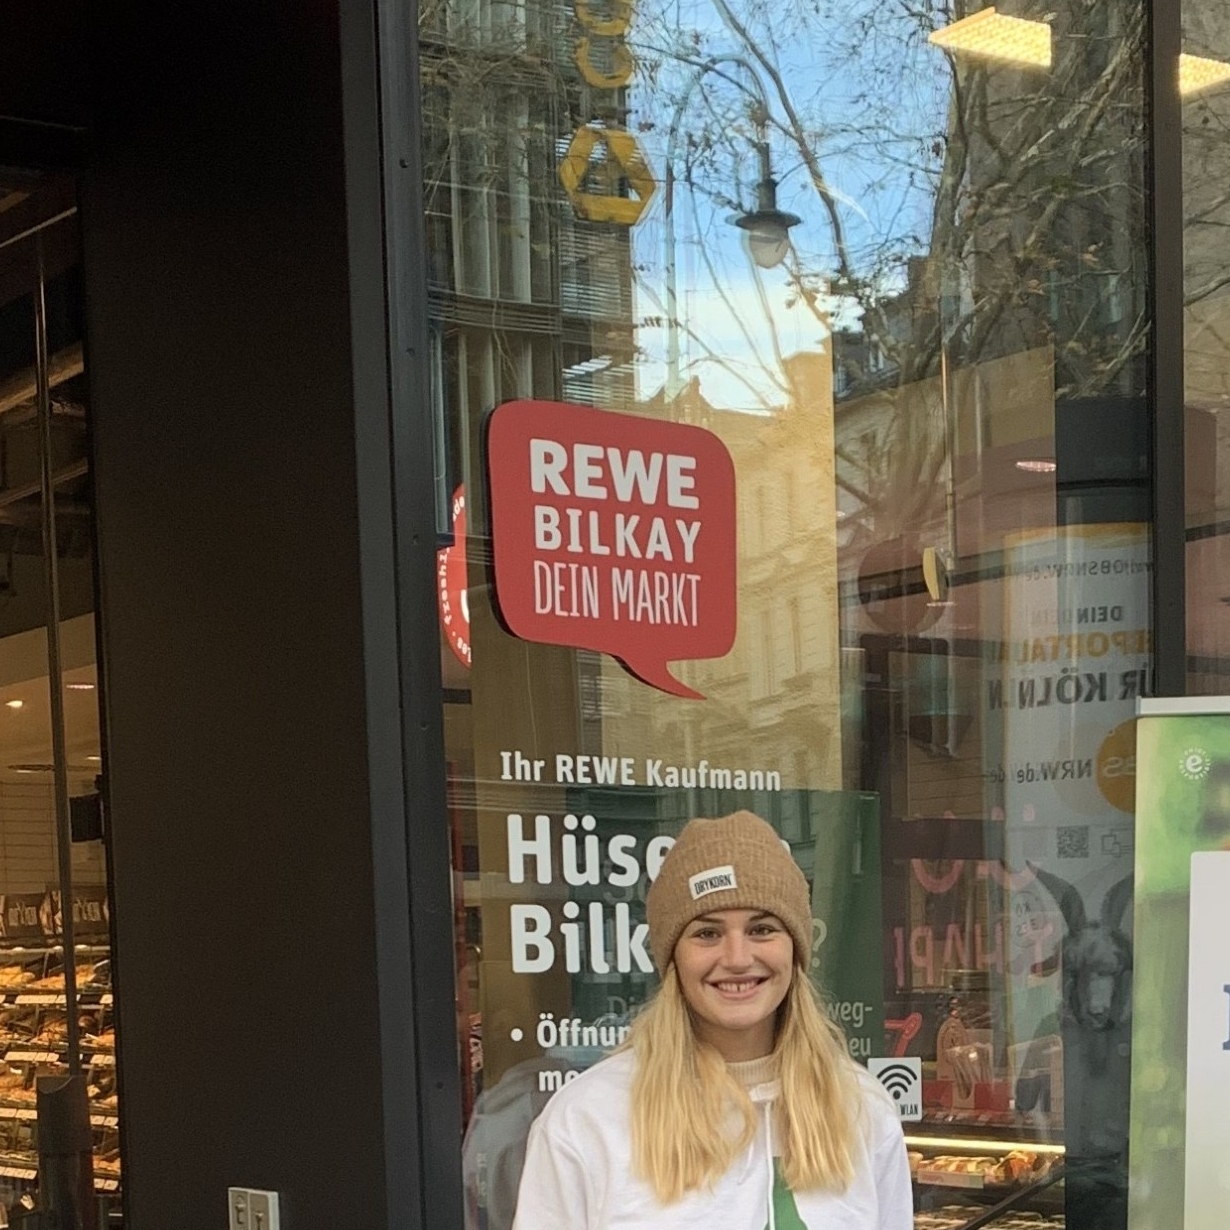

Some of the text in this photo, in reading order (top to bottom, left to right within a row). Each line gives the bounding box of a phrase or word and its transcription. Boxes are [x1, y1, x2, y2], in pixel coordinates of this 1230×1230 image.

[530, 438, 701, 511] REWE
[534, 505, 701, 563] BILKAY
[533, 560, 701, 626] DEIN MARKT
[500, 751, 782, 792] Ihr REWE Kaufmann
[694, 873, 732, 897] DRYKORN
